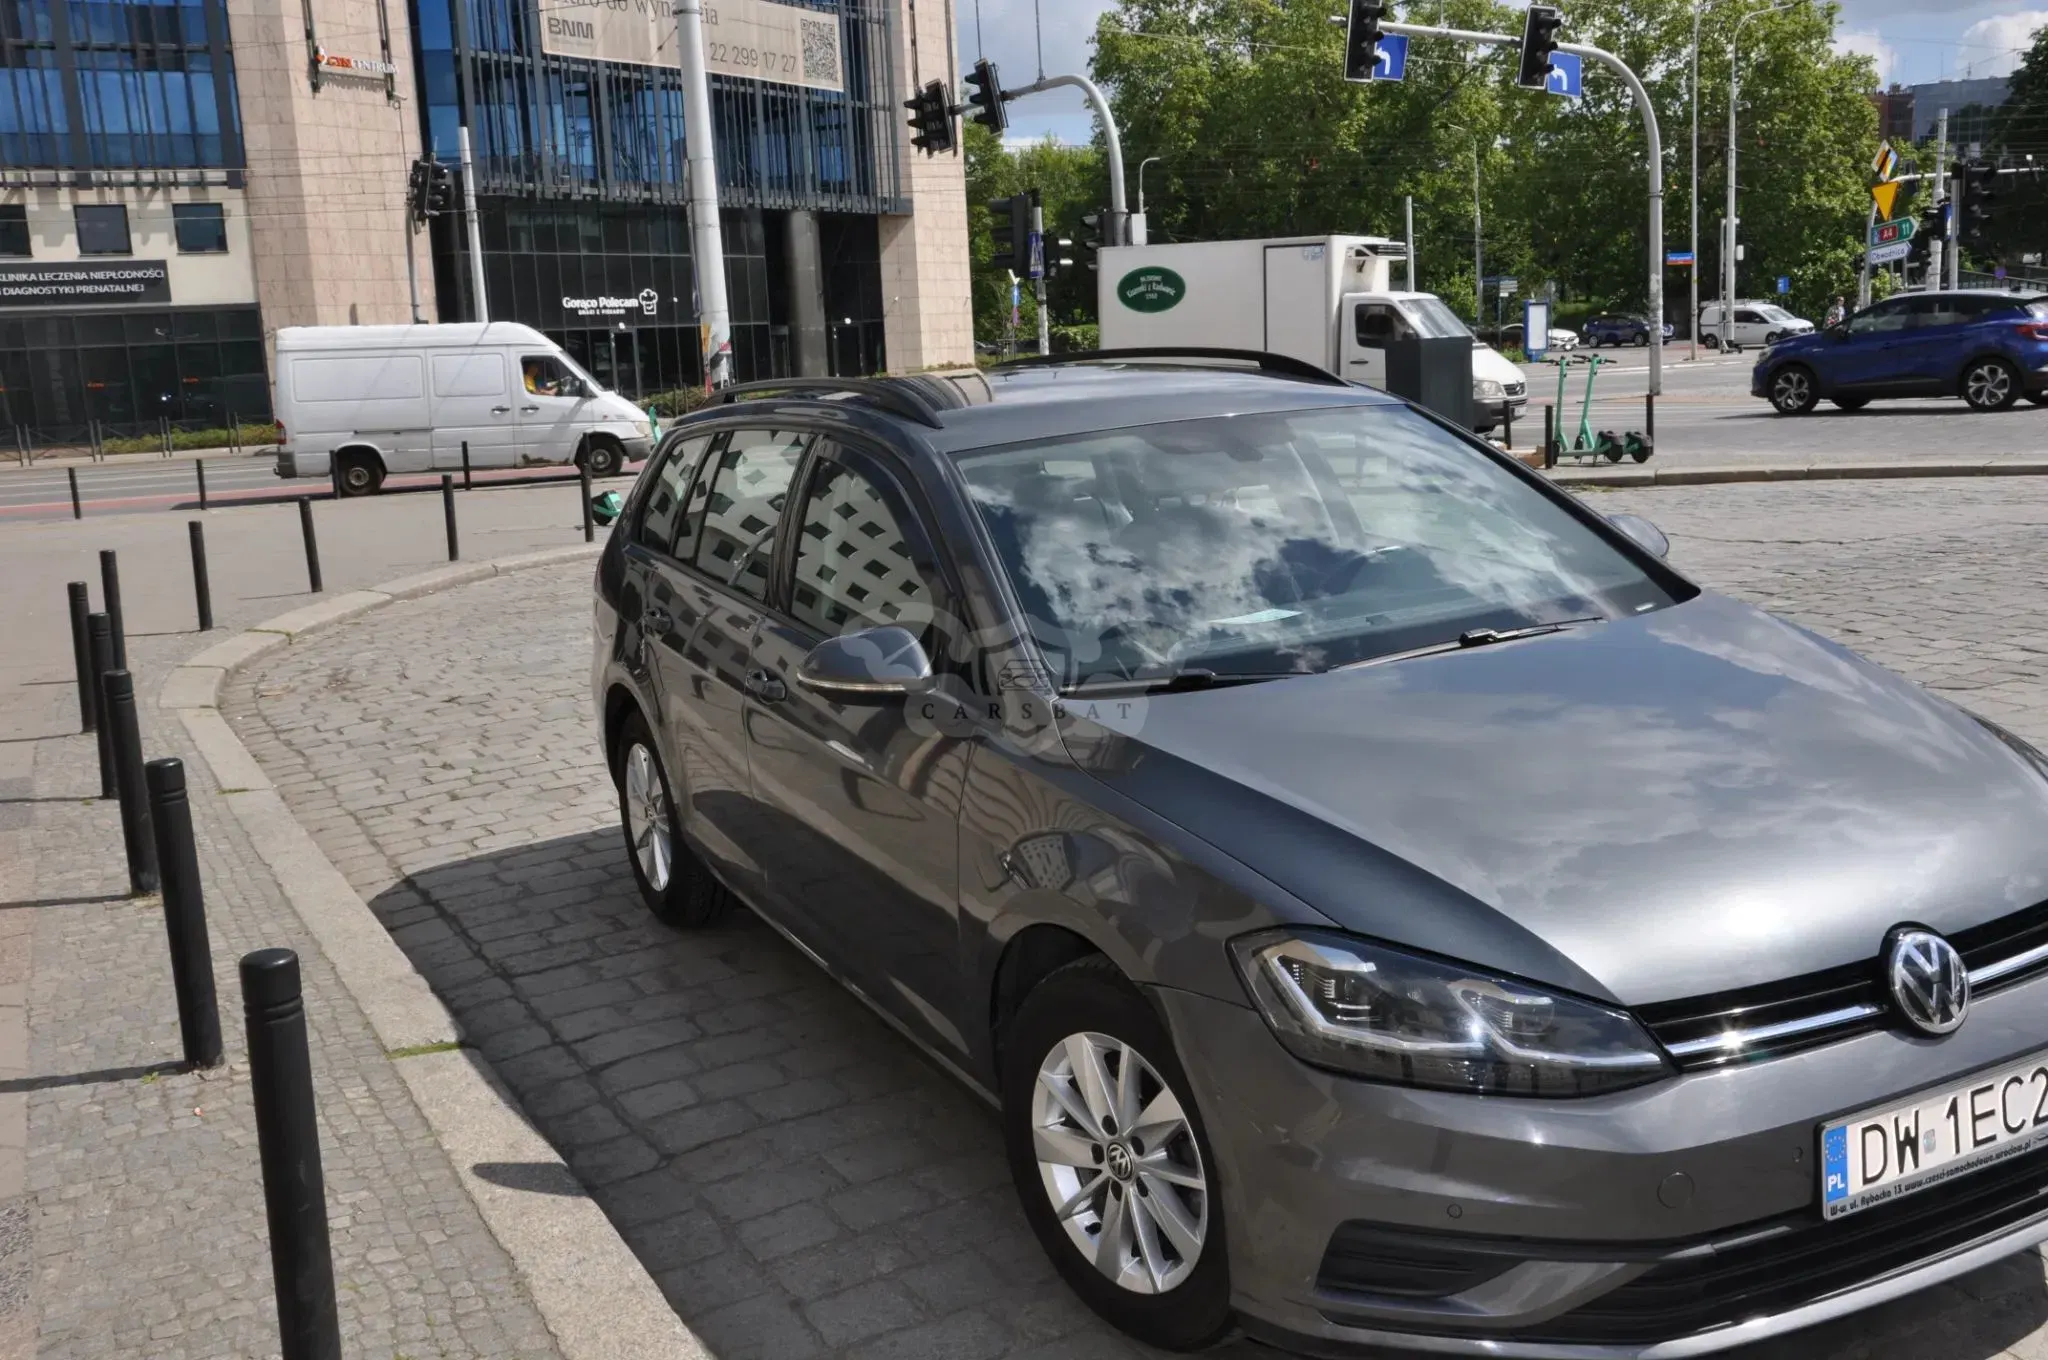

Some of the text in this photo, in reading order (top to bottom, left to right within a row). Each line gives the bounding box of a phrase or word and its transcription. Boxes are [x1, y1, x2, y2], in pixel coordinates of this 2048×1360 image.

[547, 16, 594, 40] BNM
[709, 41, 797, 73] 22 299 17 27
[1901, 221, 1910, 236] 11
[39, 270, 88, 281] LECZENIA
[90, 267, 165, 280] NIEPŁODNOŚCI
[3, 286, 74, 296] DIAGNOSTYKI
[76, 283, 145, 294] PRENATALNEJ
[598, 296, 639, 308] Polecam
[1860, 1066, 2048, 1187] DW 1EC2
[1827, 1172, 1846, 1193] PL
